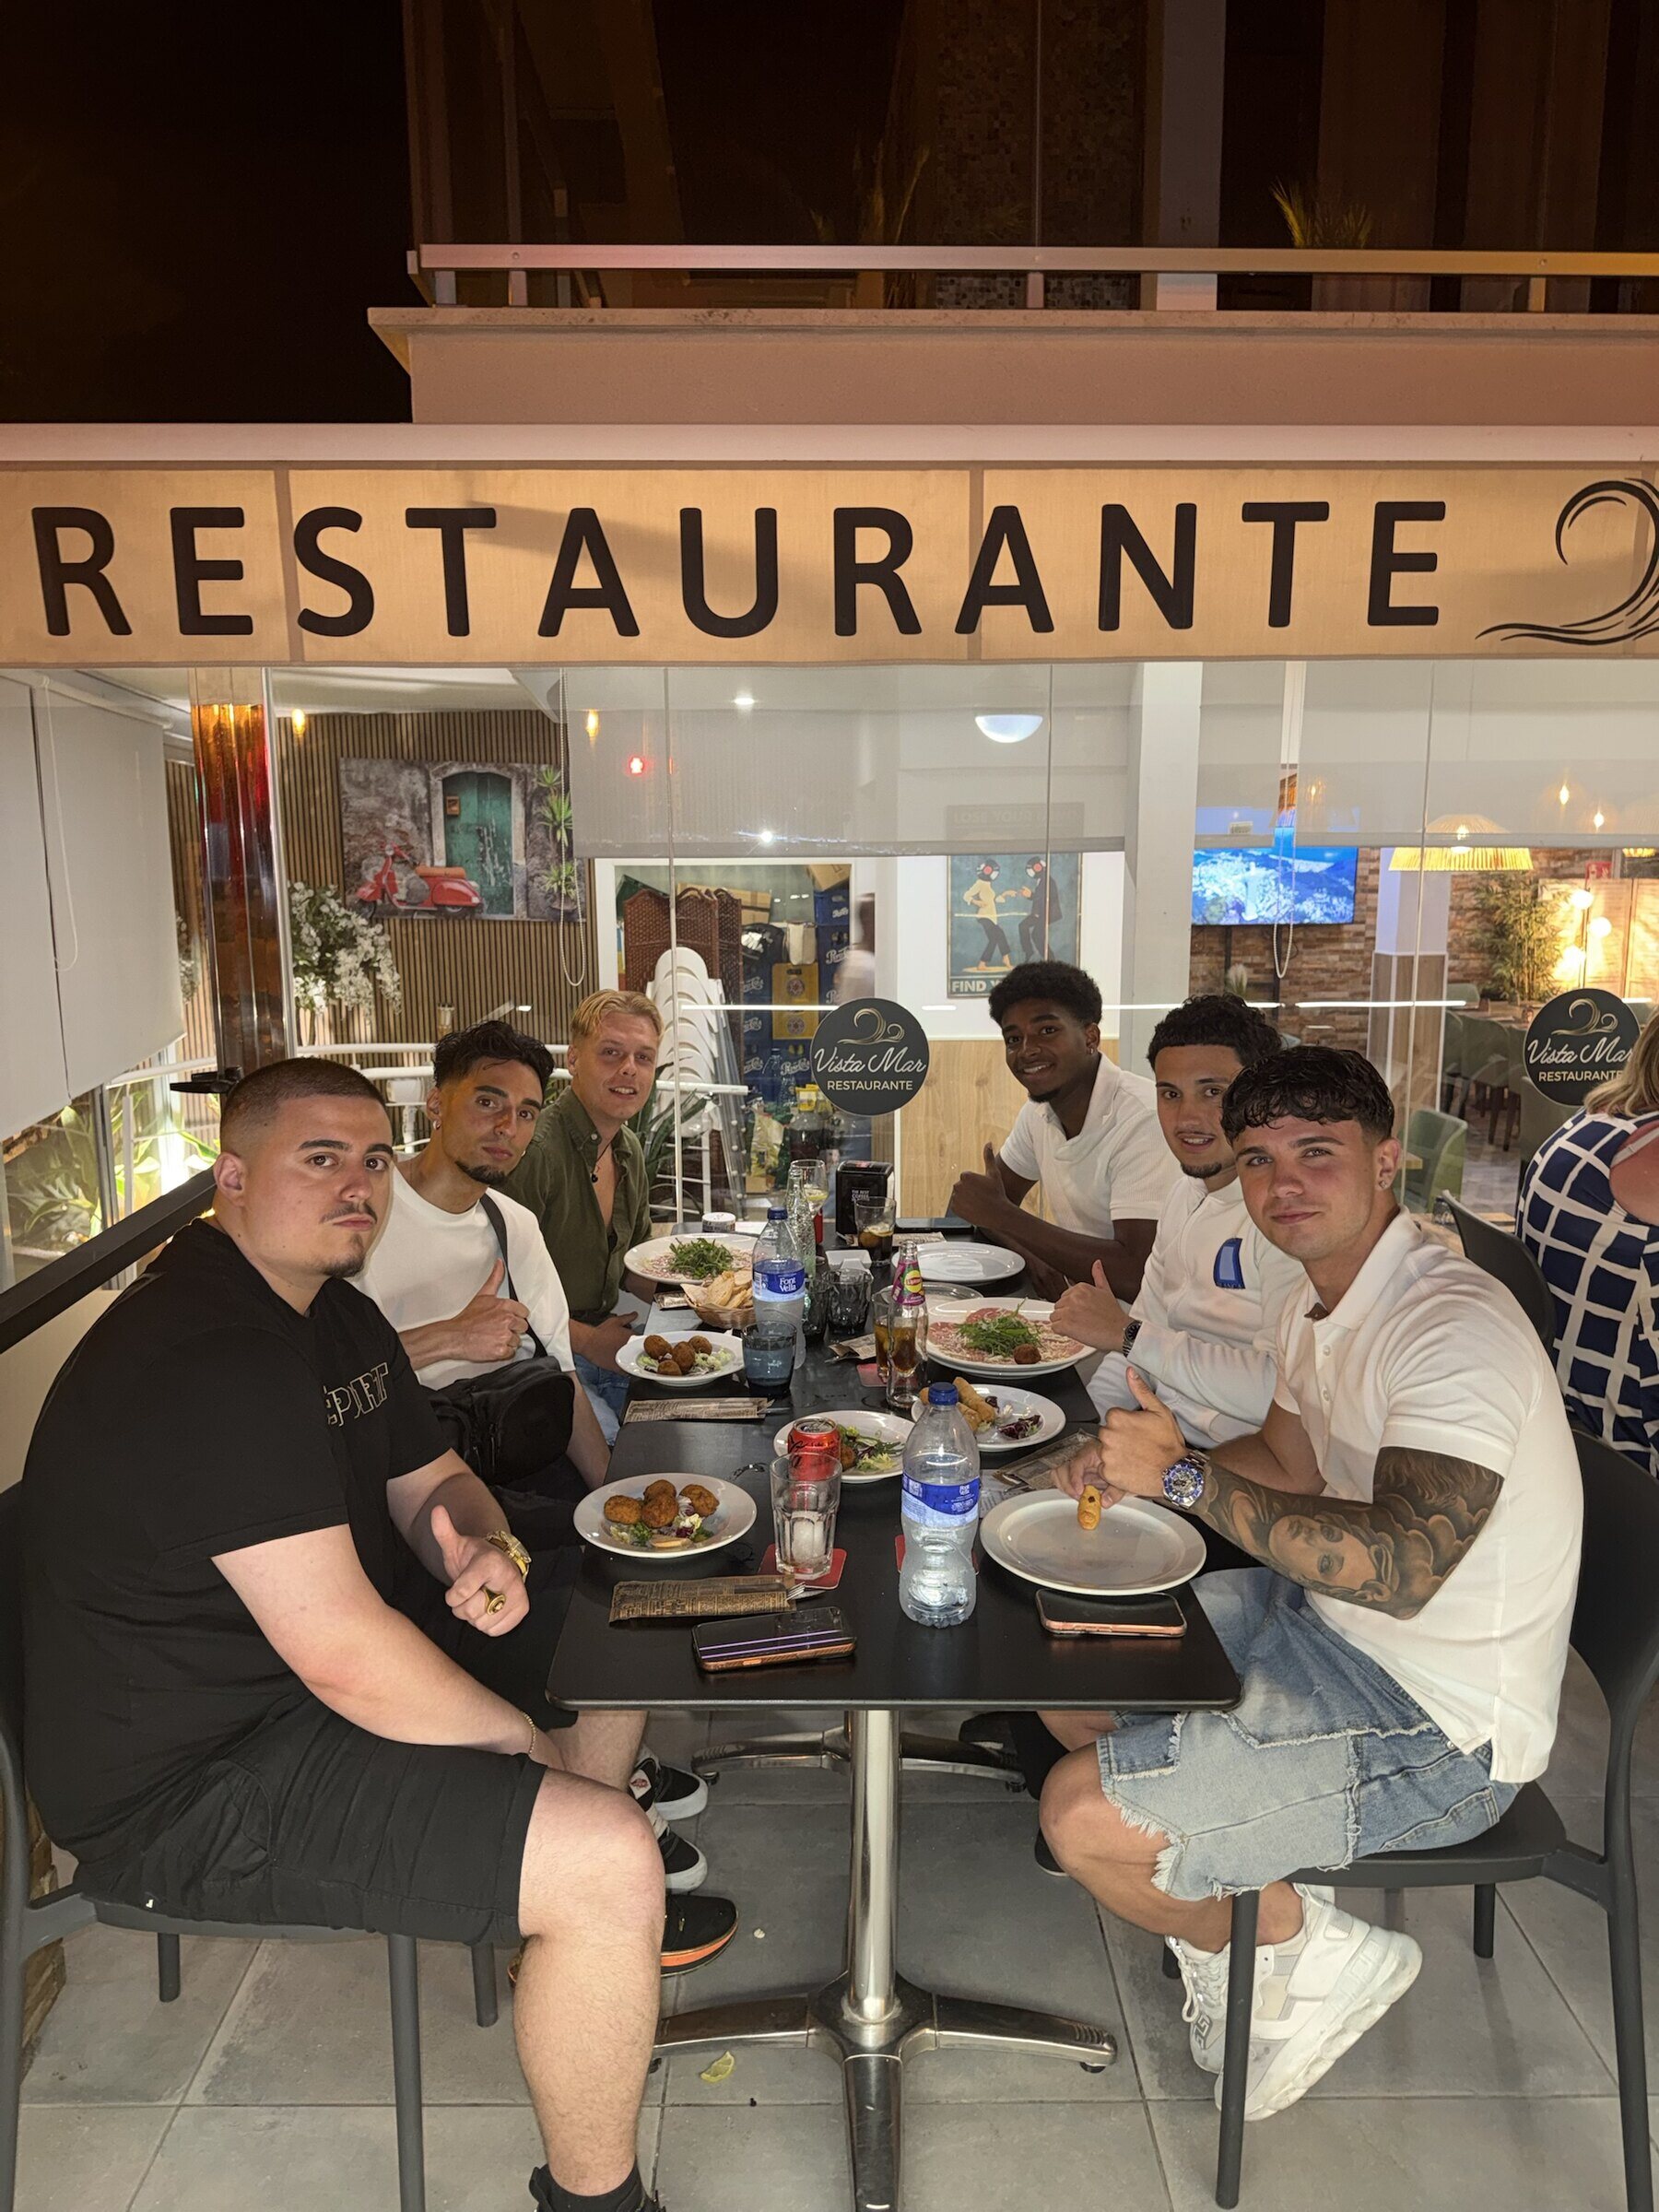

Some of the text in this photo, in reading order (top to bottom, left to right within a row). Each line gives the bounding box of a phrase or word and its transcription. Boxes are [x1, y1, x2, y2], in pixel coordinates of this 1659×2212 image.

[32, 501, 1446, 637] RESTAURANTE
[951, 980, 987, 993] FIND
[1527, 1038, 1579, 1064] Vista
[814, 1046, 927, 1073] Vista Mar
[827, 1080, 913, 1090] RESTAURANTE
[779, 1277, 796, 1285] Font
[779, 1284, 797, 1292] Vella
